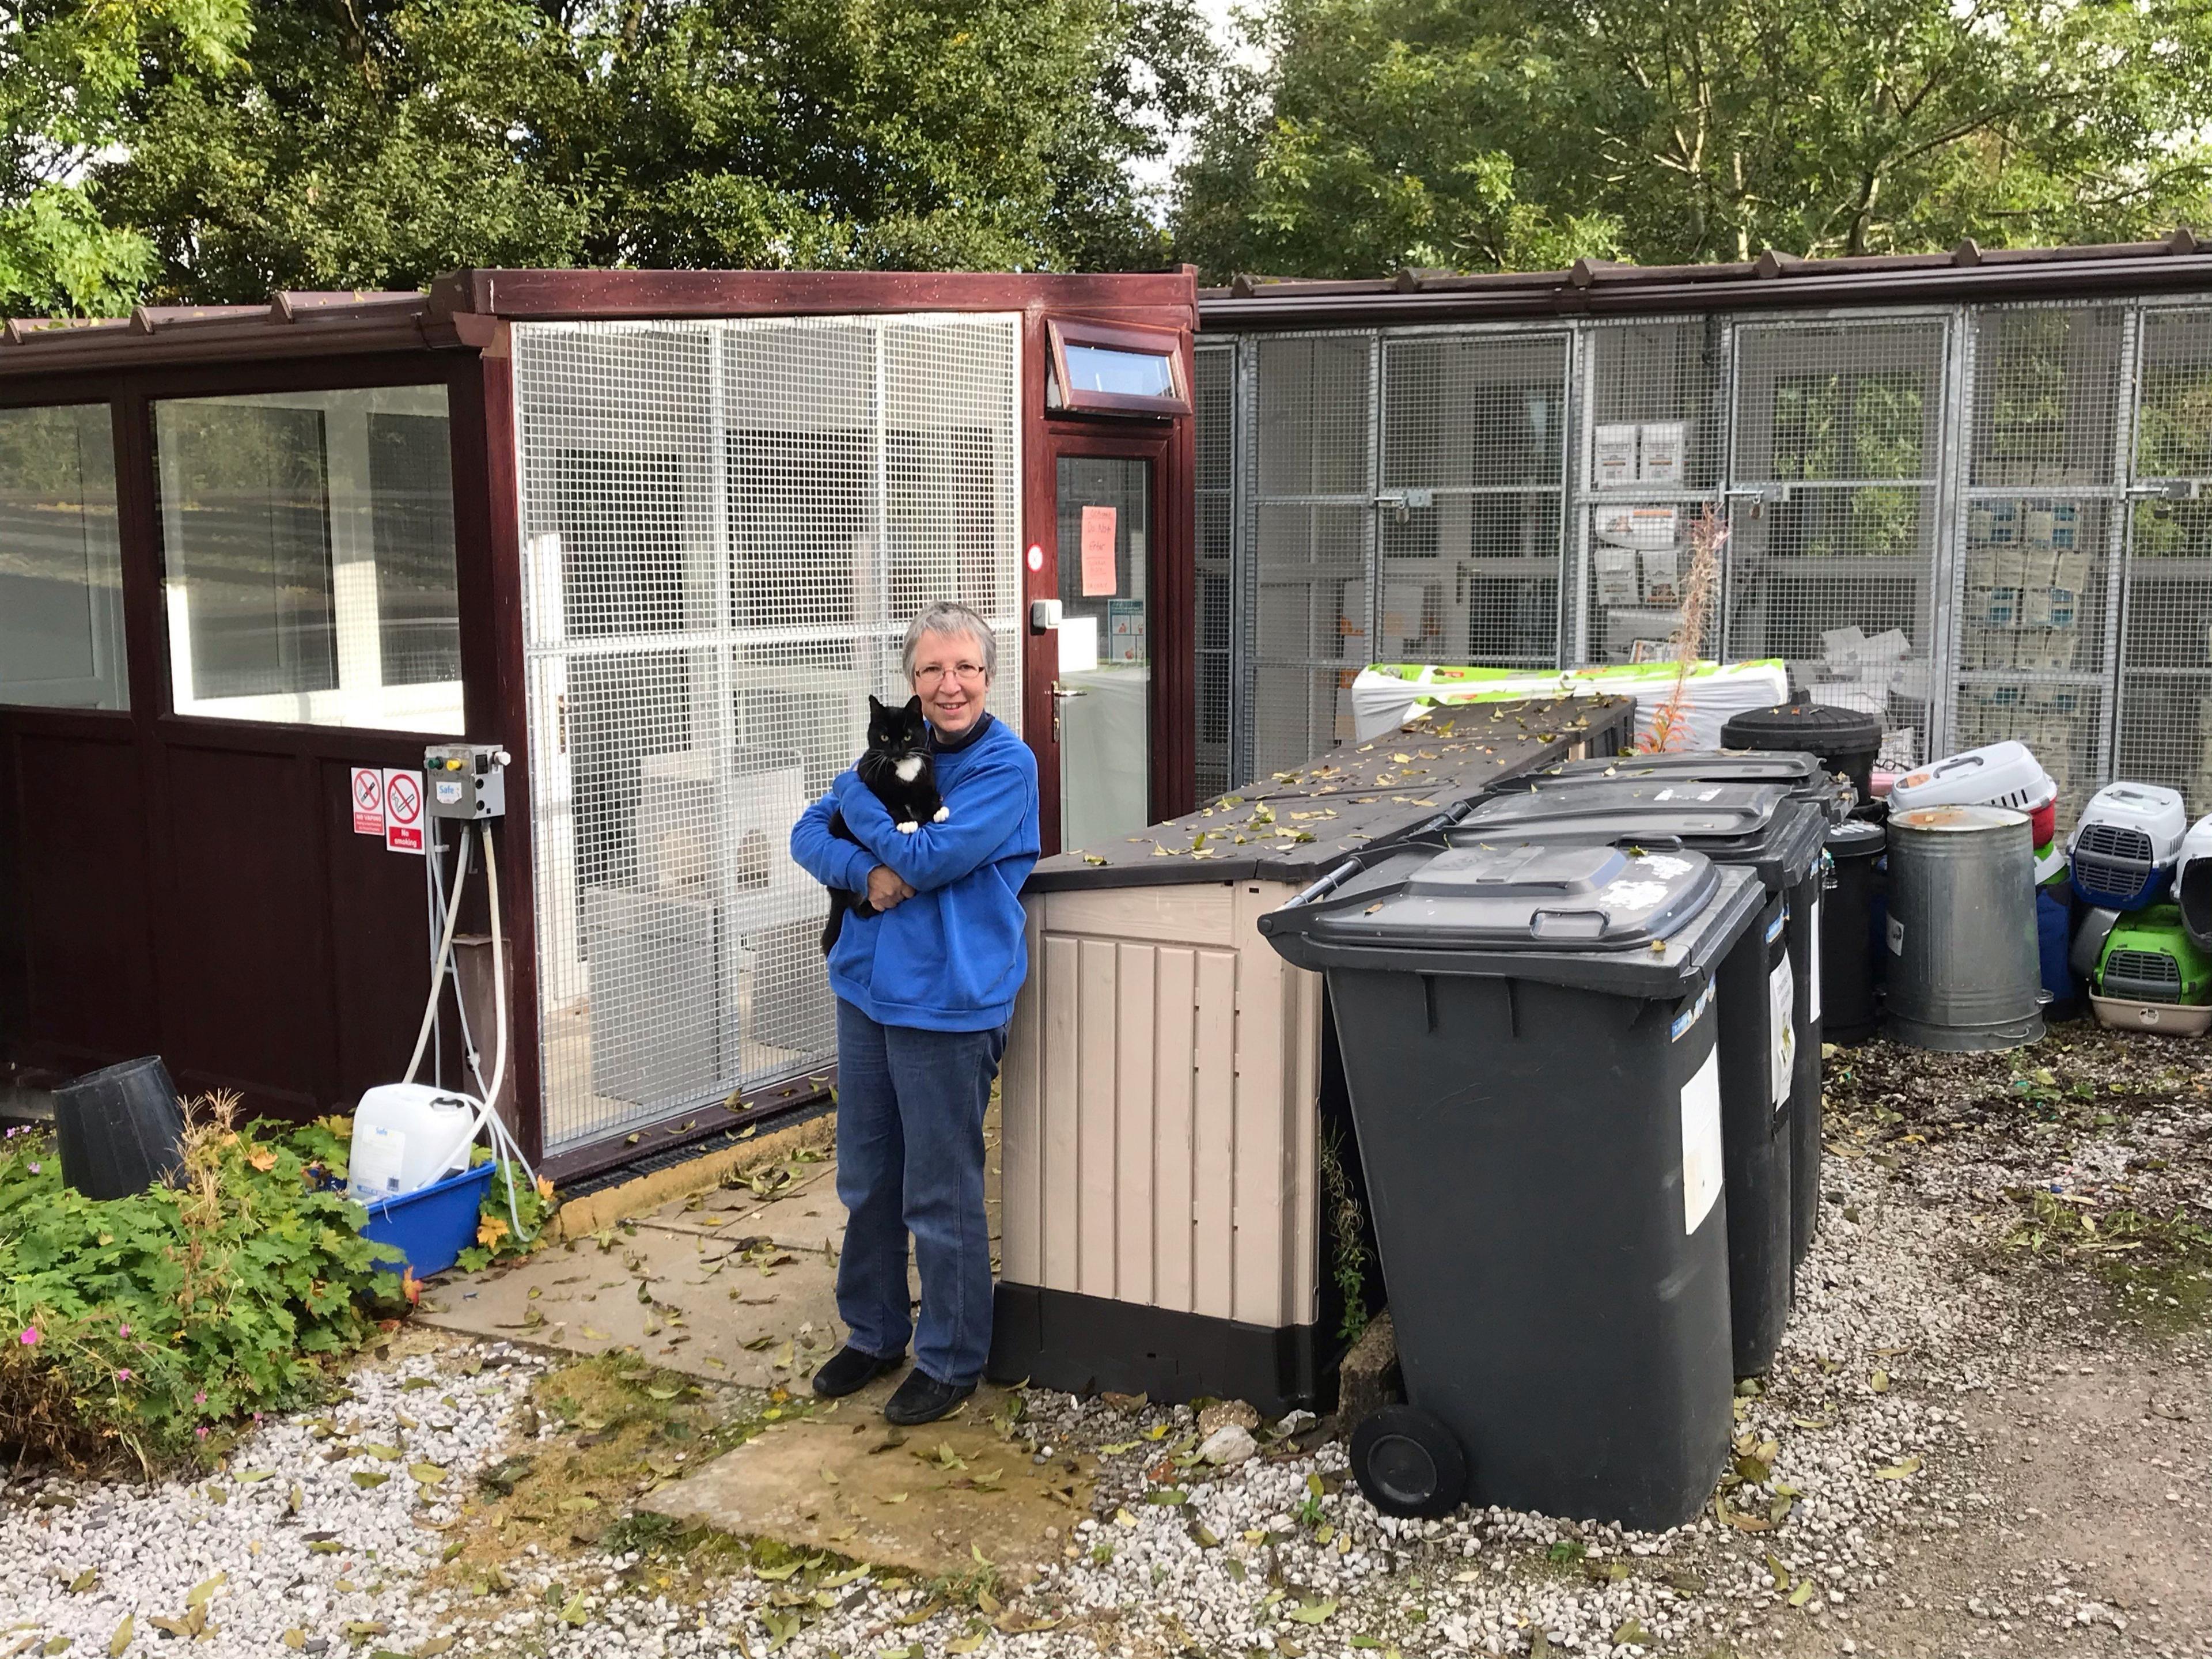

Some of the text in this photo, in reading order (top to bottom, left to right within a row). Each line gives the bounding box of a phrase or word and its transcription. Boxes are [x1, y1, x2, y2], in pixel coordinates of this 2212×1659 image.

[439, 785, 454, 794] Safe
[401, 829, 410, 837] No
[394, 838, 417, 847] smoking
